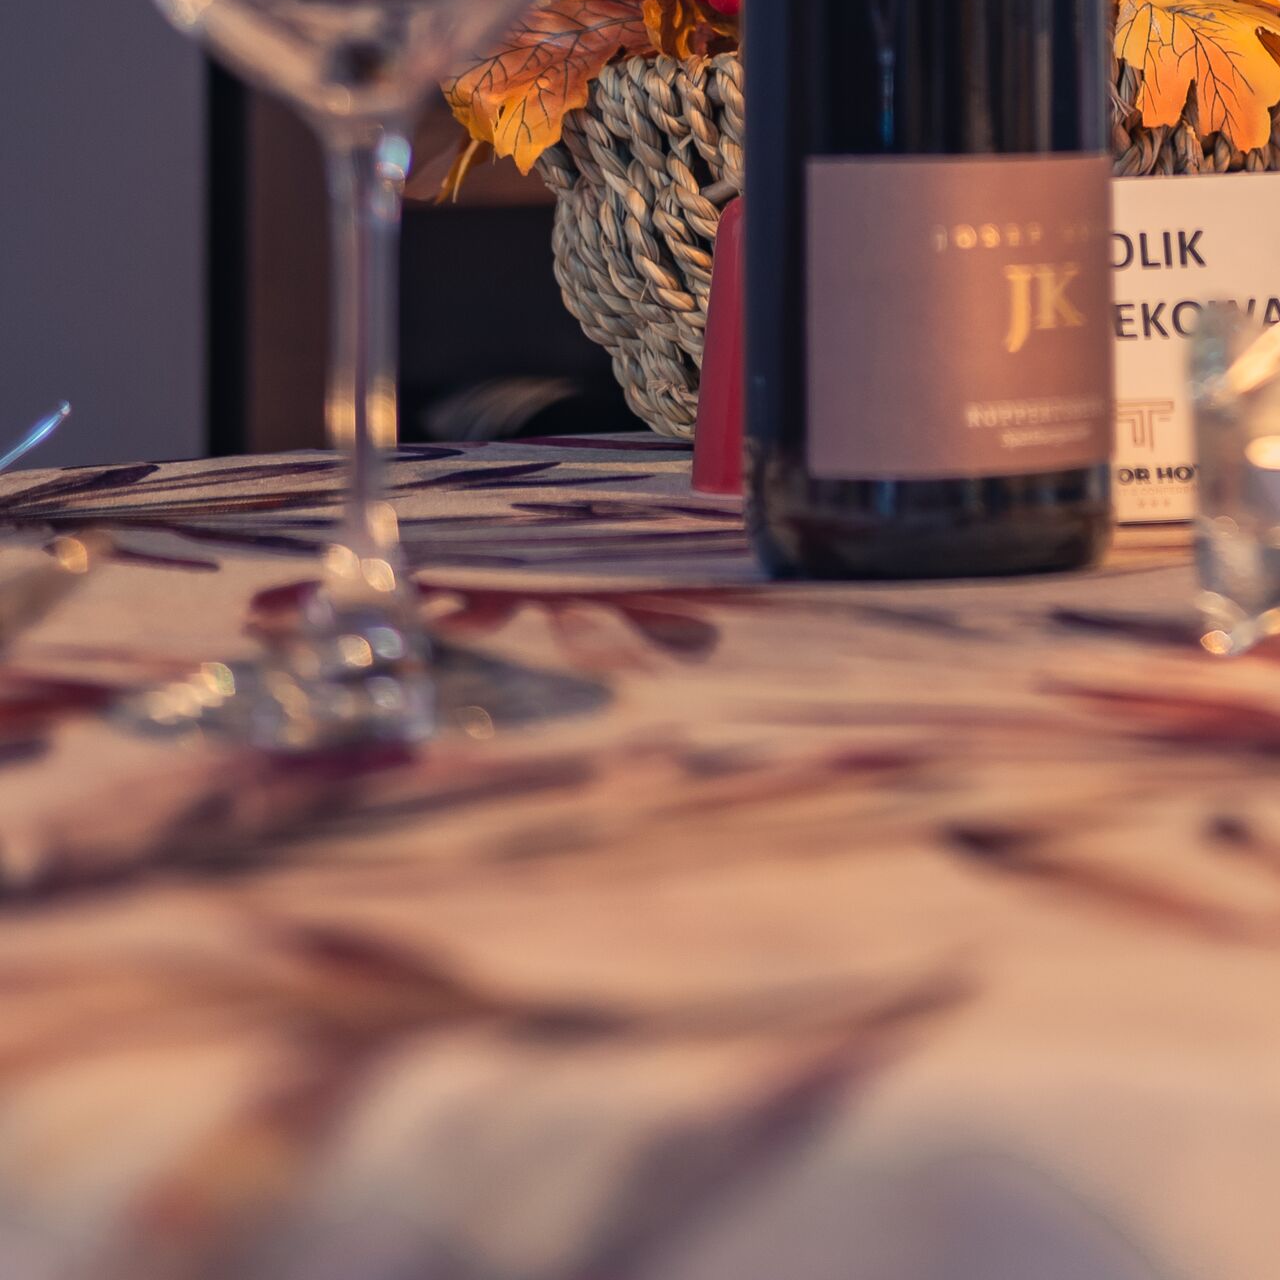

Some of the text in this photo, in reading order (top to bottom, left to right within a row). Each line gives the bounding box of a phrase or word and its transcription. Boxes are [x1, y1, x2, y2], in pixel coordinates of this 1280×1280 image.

[1111, 229, 1206, 269] OLIK
[1003, 264, 1086, 352] JK
[1156, 465, 1200, 483] HO
